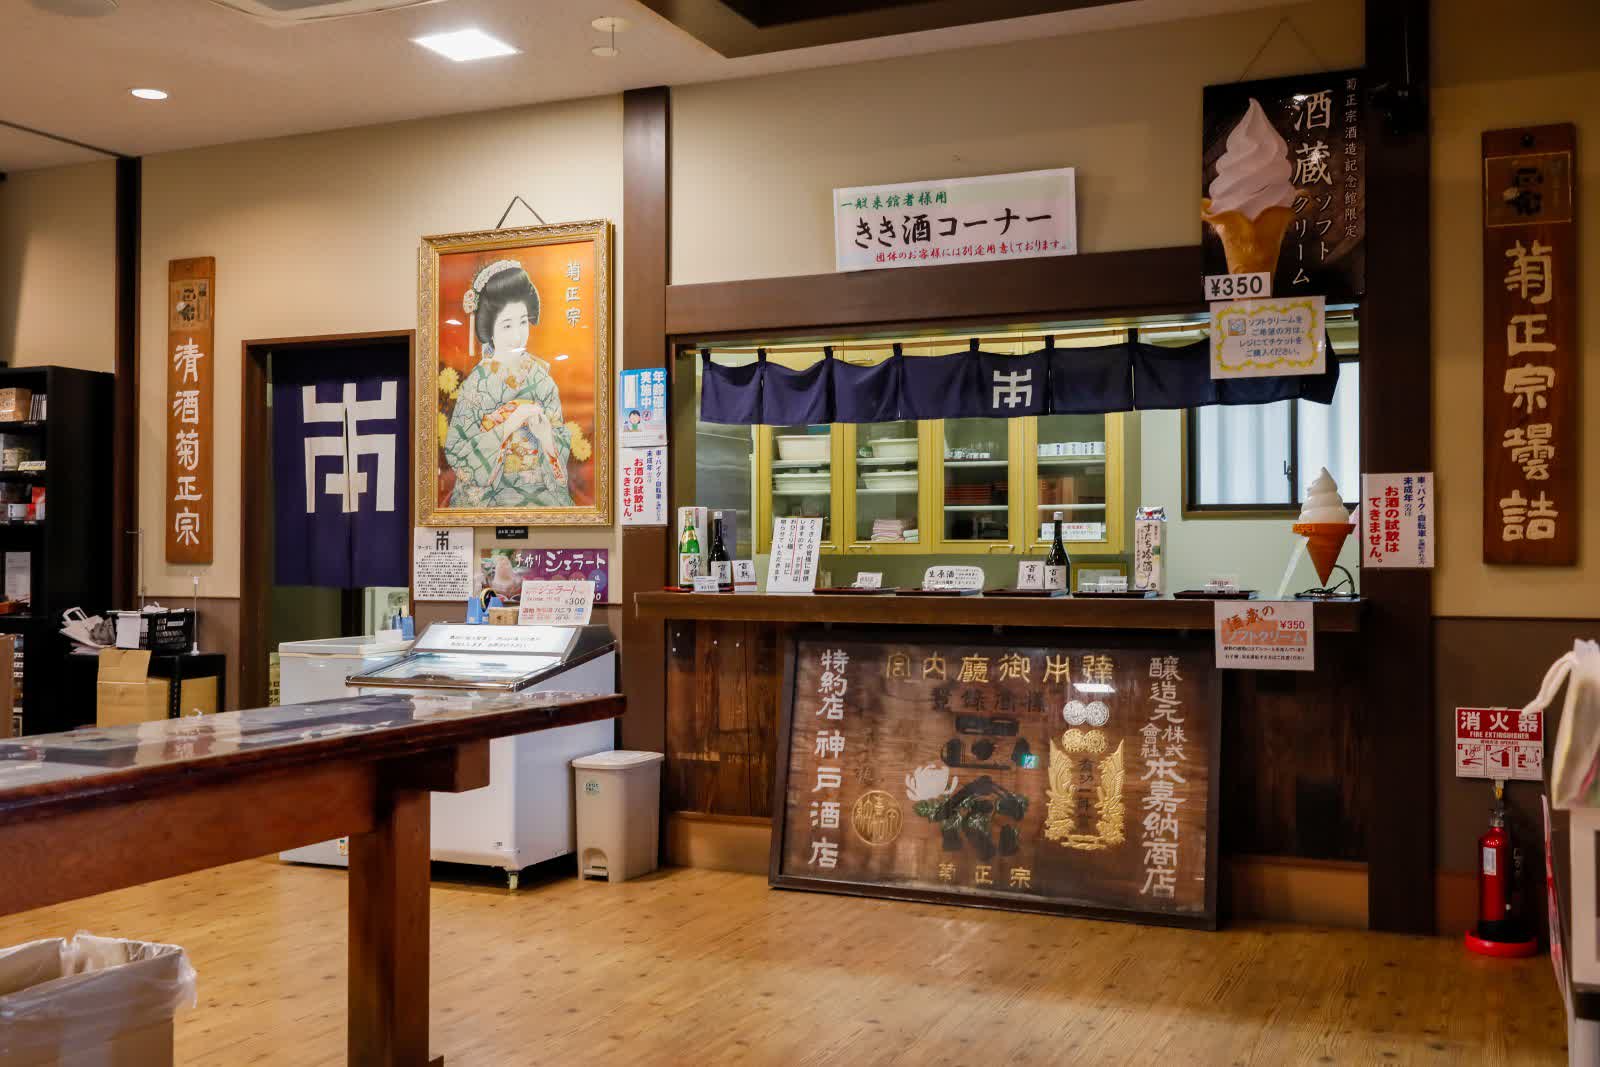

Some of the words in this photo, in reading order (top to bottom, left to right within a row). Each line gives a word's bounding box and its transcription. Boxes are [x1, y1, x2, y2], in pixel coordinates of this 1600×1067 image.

[1293, 89, 1333, 185] 酒蔵
[1344, 78, 1358, 239] 菊正宗酒造記念館限定
[841, 191, 948, 210] 一般来館者様用
[1316, 193, 1332, 261] ソフト
[855, 207, 1052, 249] きき酒コーナー
[875, 240, 1067, 263] 団体のお客様には別途用意しております。
[1292, 196, 1310, 285] クリーム
[566, 262, 581, 328] 菊正宗
[1211, 276, 1263, 296] ¥350
[640, 371, 652, 409] 実施中
[173, 337, 204, 546] 清酒菊正宗
[623, 467, 633, 521] できません。
[633, 458, 644, 513] お酒の試飲は
[1369, 497, 1382, 563] できません。
[1385, 486, 1399, 552] お酒の試飲は
[545, 550, 606, 572] ジェラート
[1280, 620, 1305, 630] ¥350
[815, 649, 850, 720] 特約店
[1461, 711, 1538, 732] 消火器
[1485, 731, 1529, 739] EXTINGUISHER
[807, 730, 846, 869] 神戸酒店
[938, 862, 1032, 889] 菊正宗
